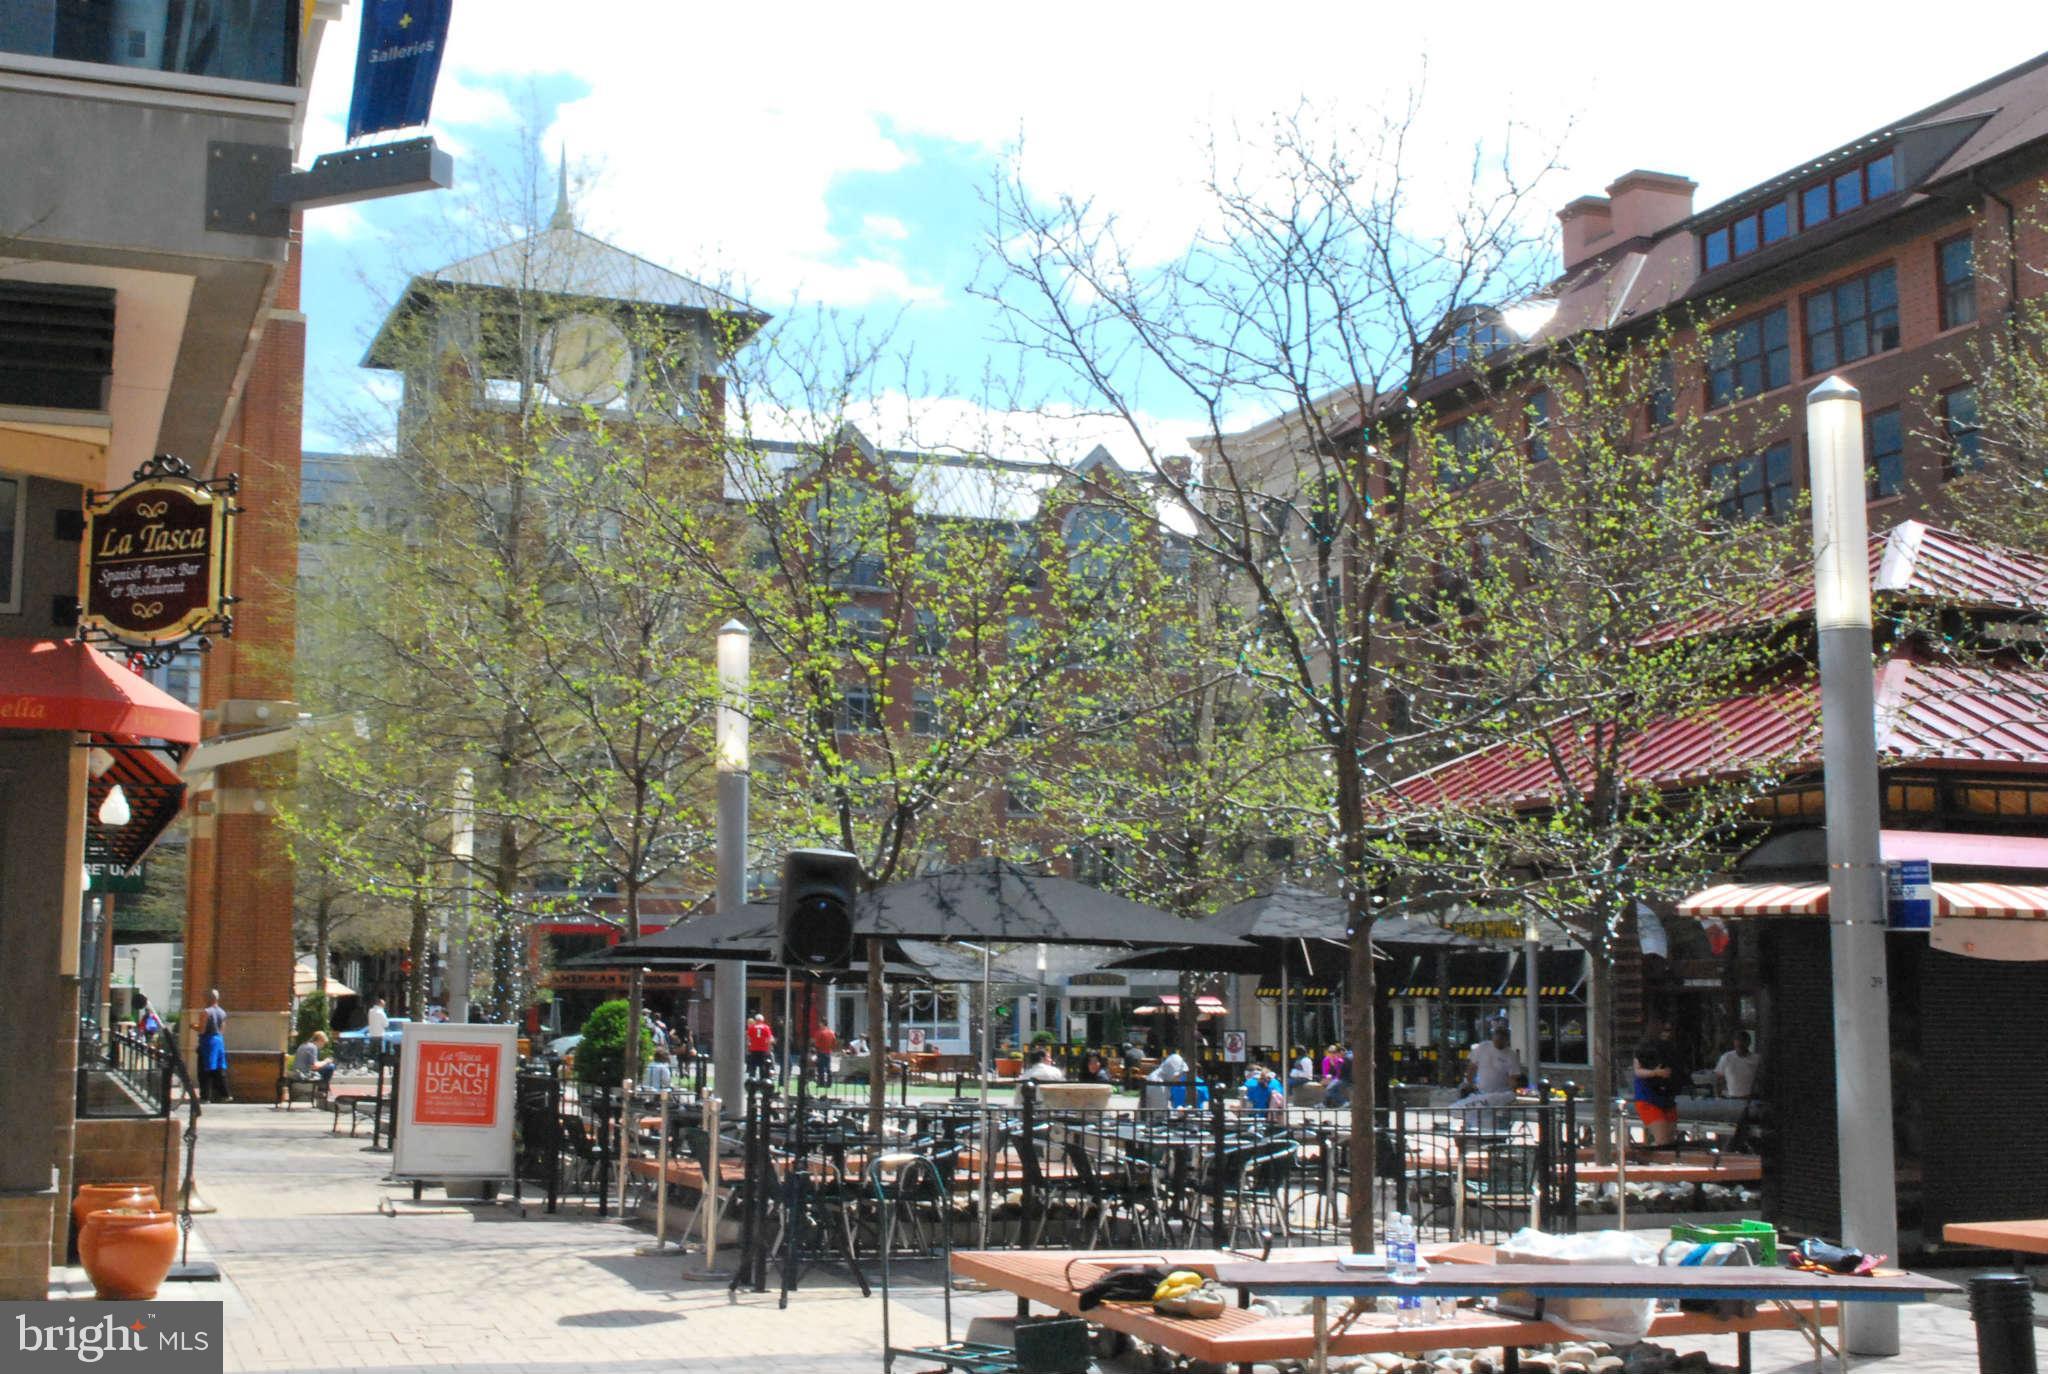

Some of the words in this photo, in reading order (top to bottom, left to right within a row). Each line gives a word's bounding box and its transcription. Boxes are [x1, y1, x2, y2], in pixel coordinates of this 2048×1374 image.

[98, 528, 133, 556] La
[140, 522, 206, 553] Tasca
[98, 564, 142, 587] Spanish
[144, 564, 177, 583] Tapas
[178, 562, 200, 577] Bar
[126, 582, 185, 599] Restaurant
[426, 1061, 490, 1078] LUNCH
[425, 1077, 489, 1095] DEALS!
